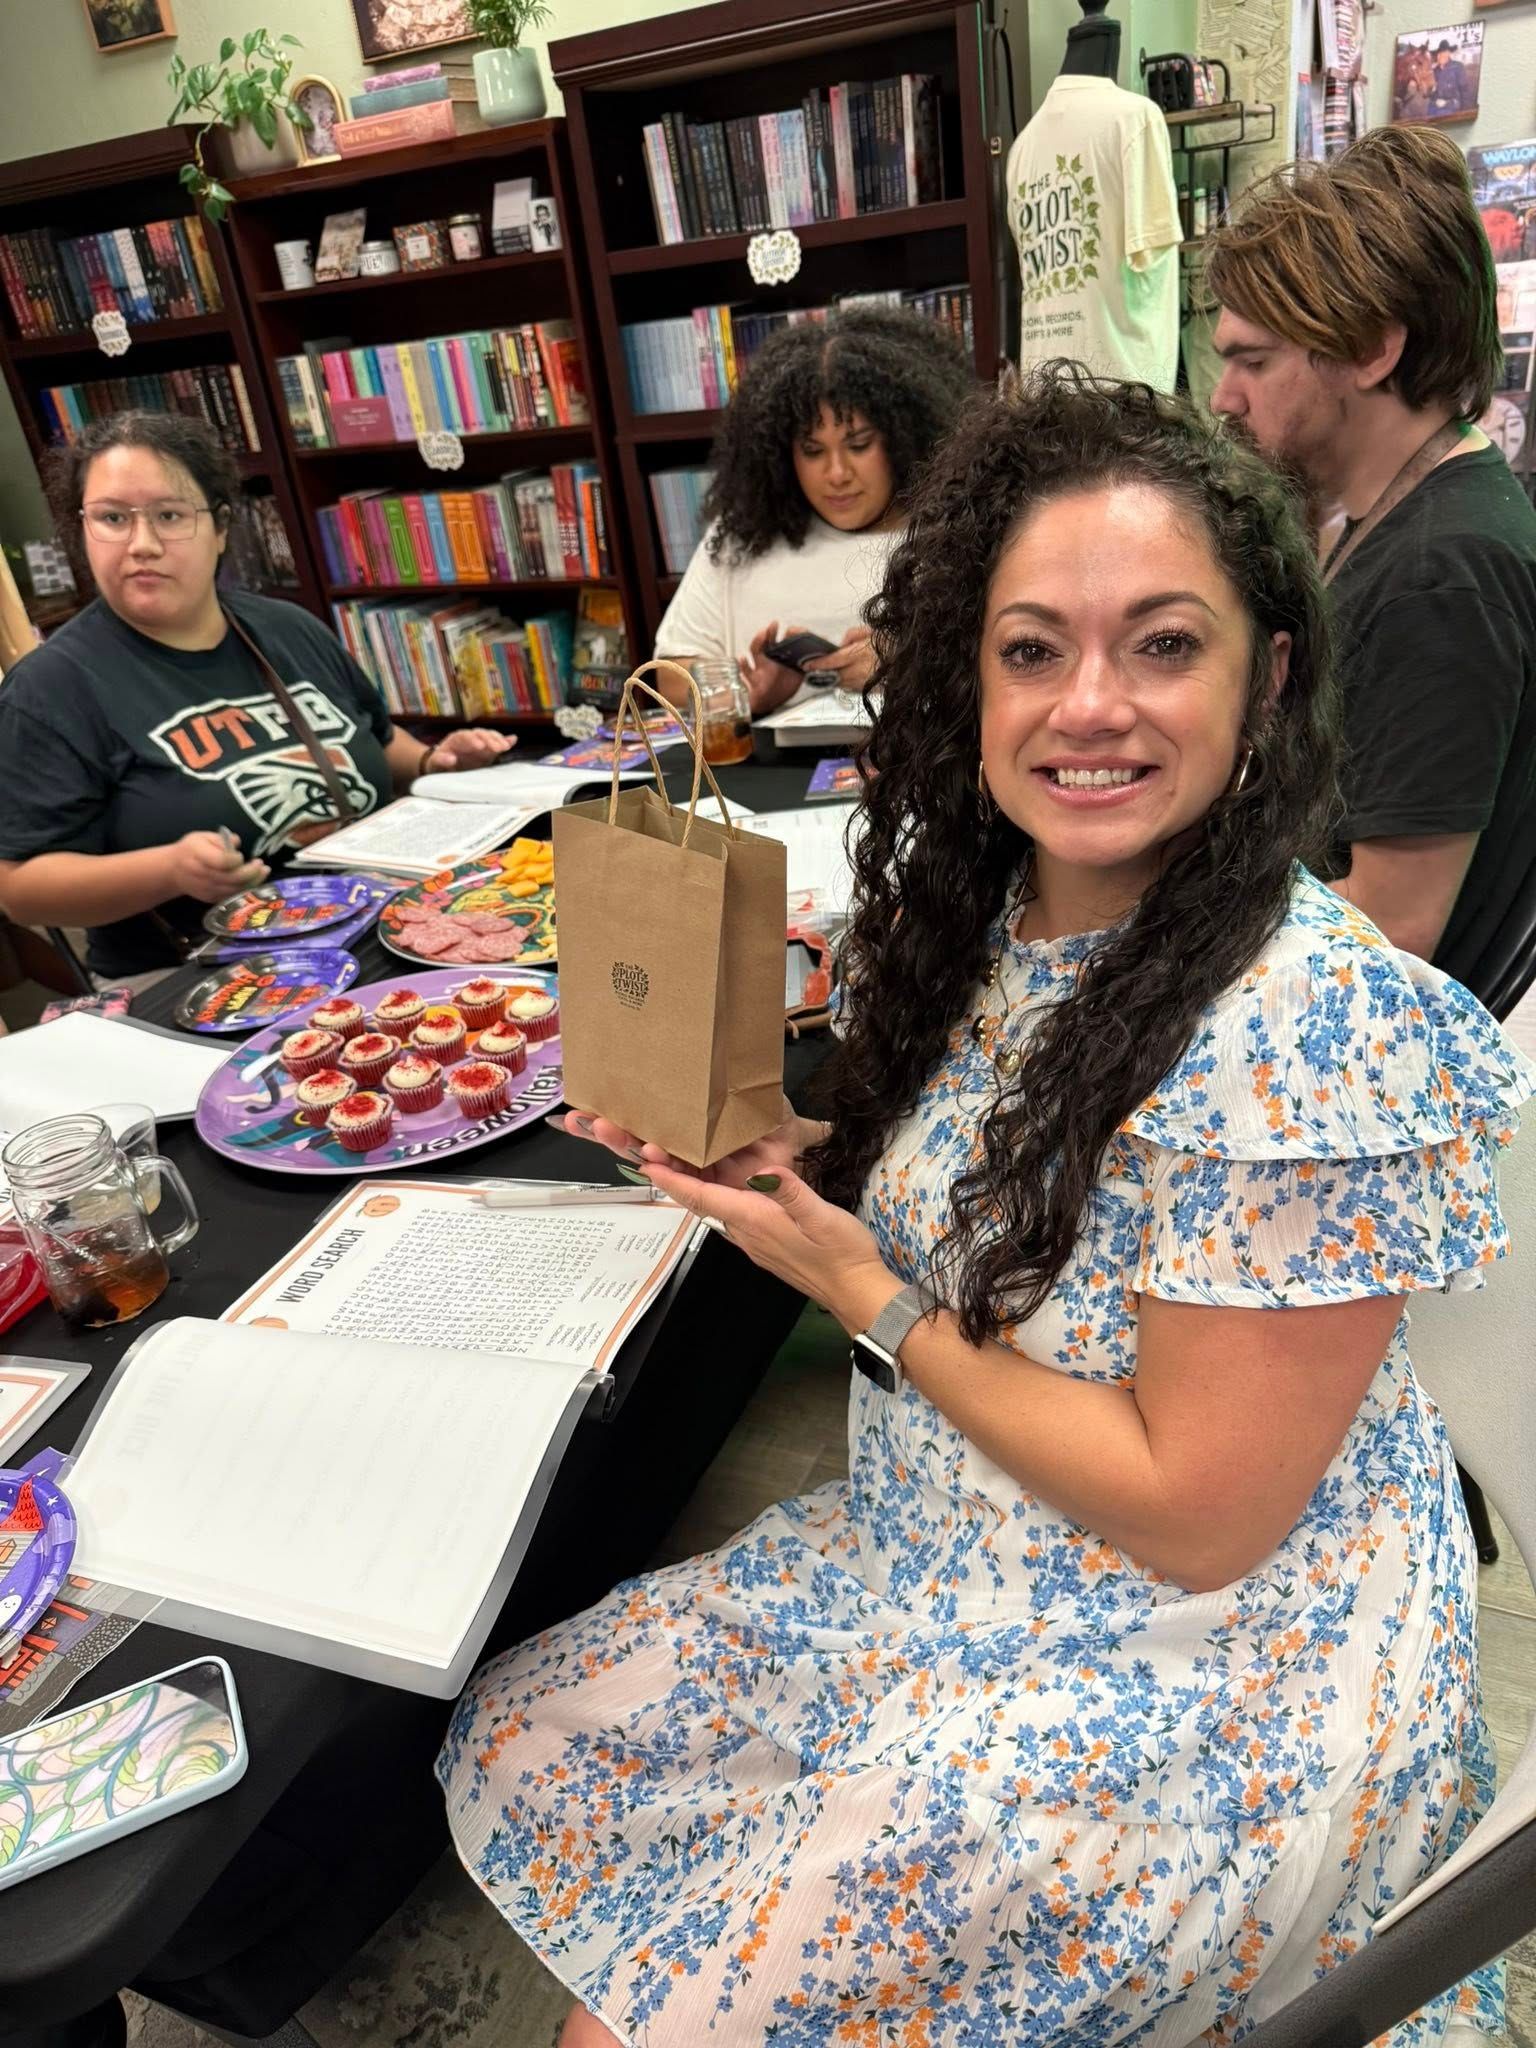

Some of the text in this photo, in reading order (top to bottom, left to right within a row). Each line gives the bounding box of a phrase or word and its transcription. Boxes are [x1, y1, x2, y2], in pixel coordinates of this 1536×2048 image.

[1029, 173, 1052, 199] THE
[615, 977, 645, 992] TWIST
[616, 967, 642, 982] PLOT
[276, 1228, 366, 1303] WORD SEARCH
